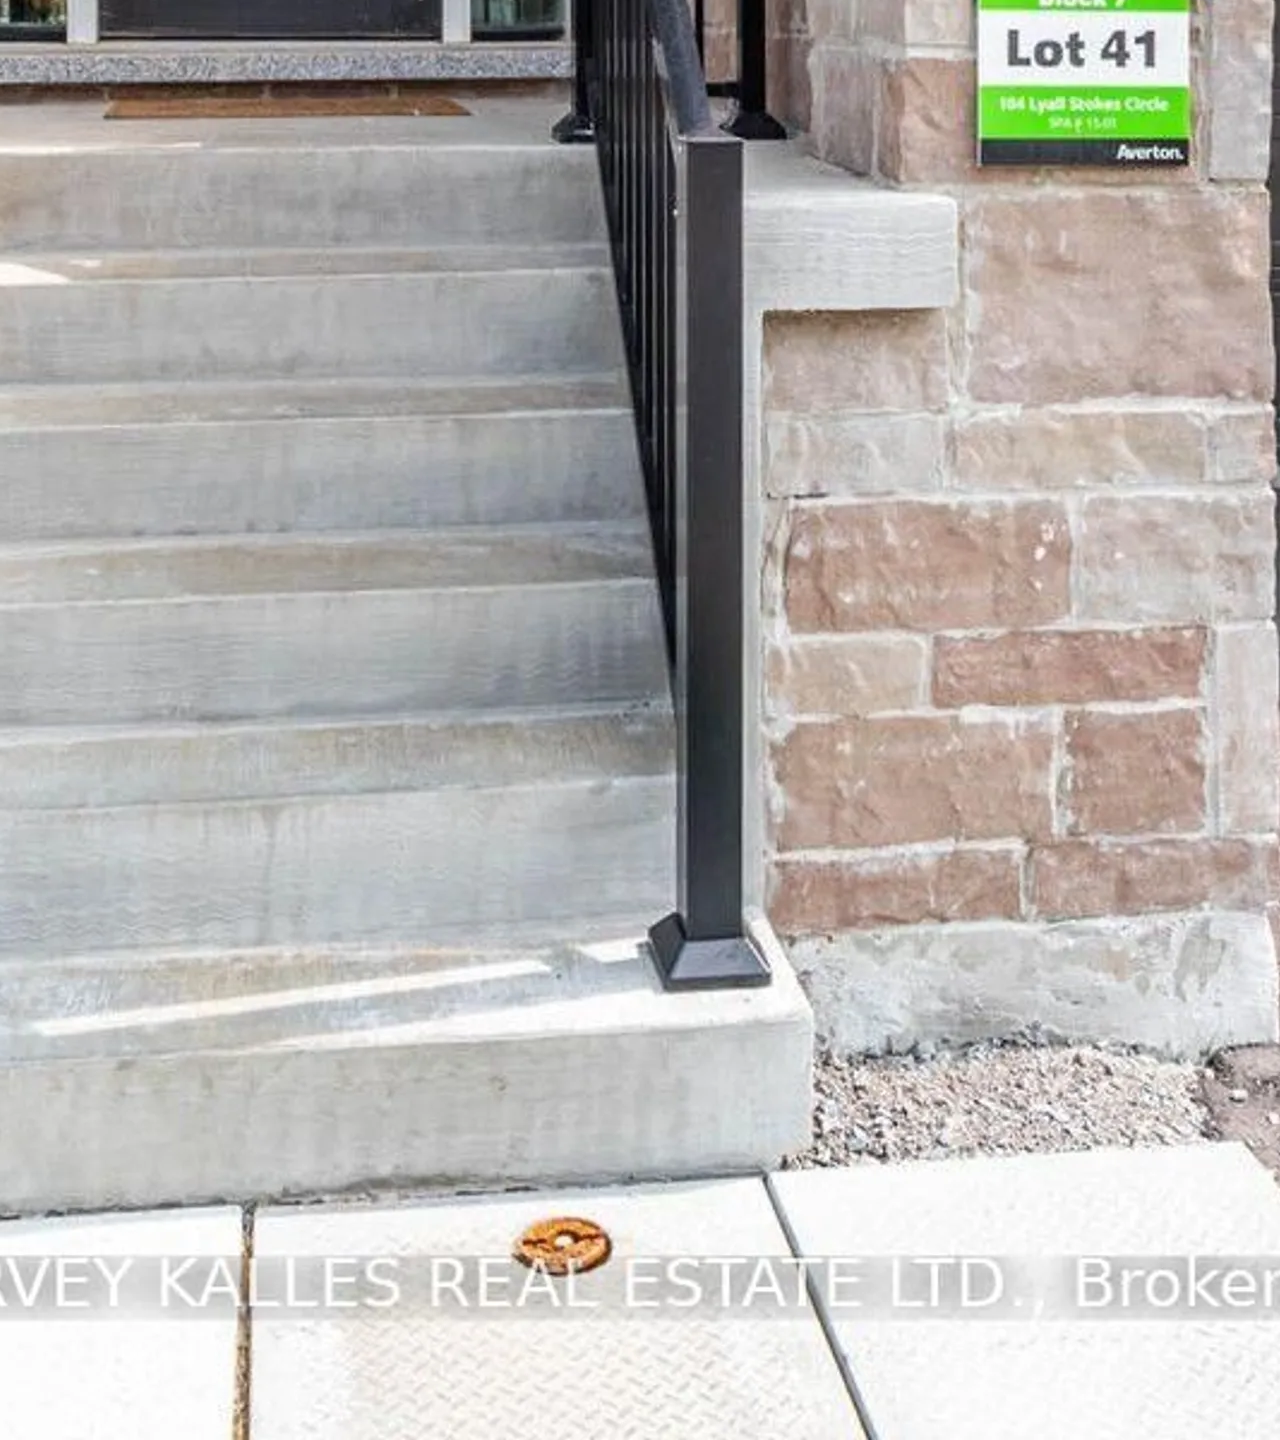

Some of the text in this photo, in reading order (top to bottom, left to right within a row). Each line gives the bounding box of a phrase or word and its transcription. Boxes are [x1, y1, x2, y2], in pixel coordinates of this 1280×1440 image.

[1007, 29, 1156, 68] Lot 41
[1124, 96, 1169, 112] Circle
